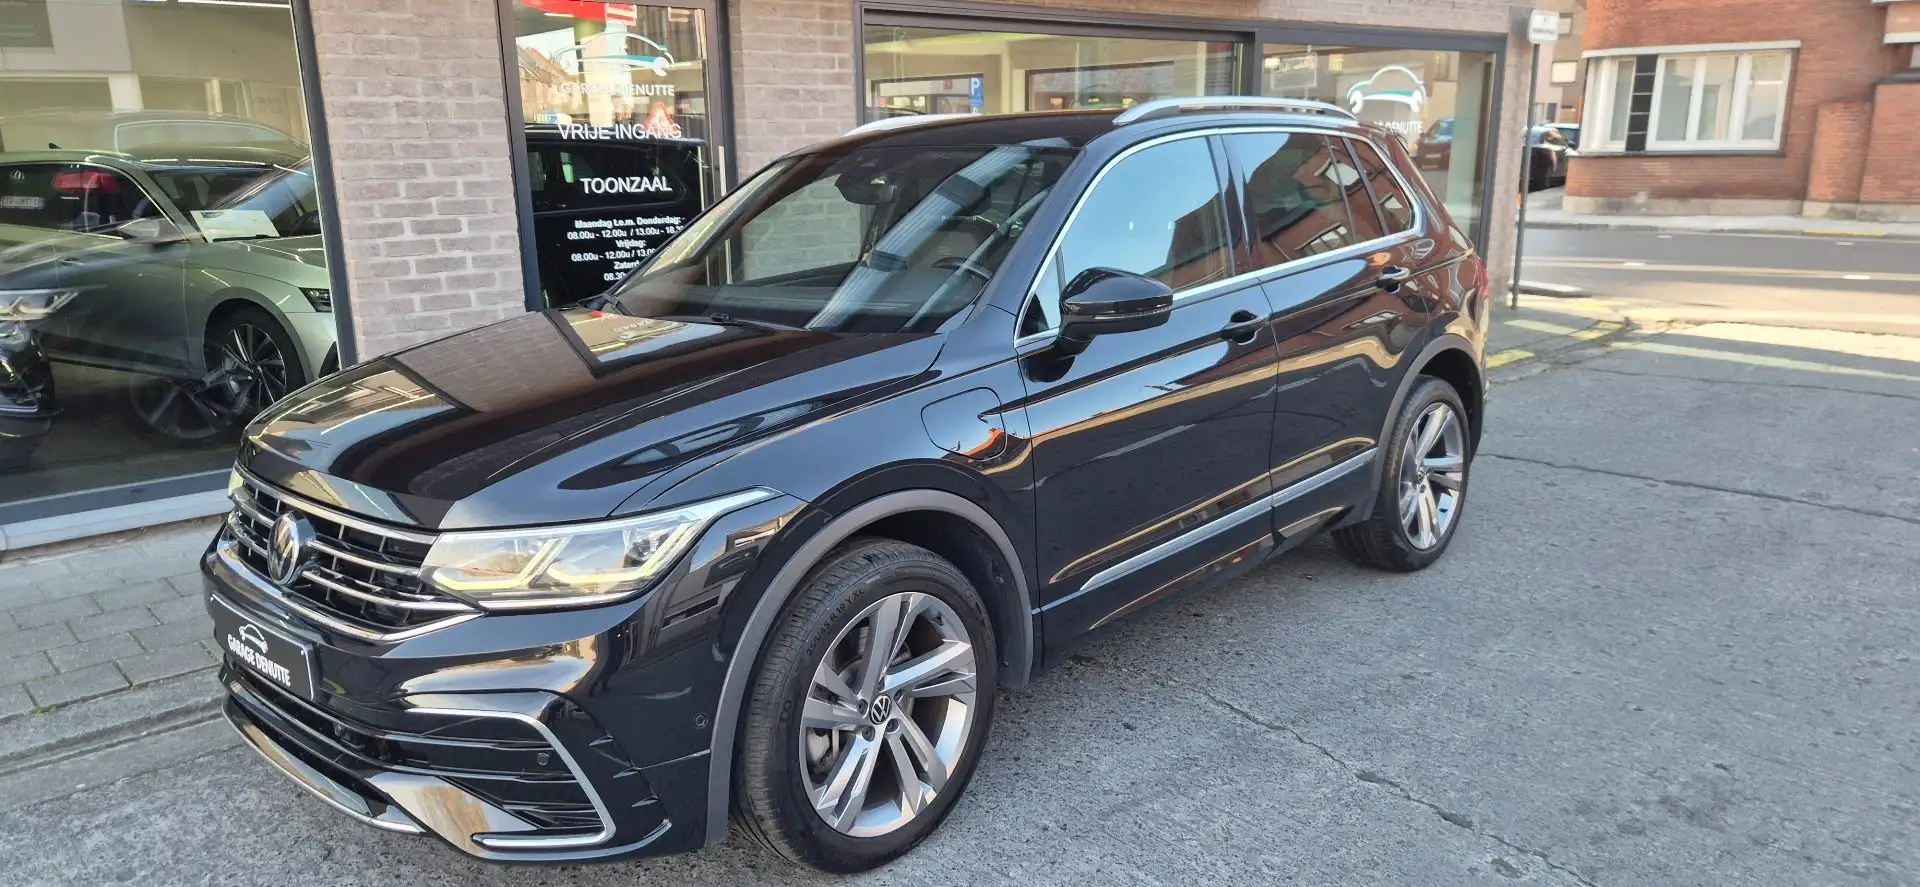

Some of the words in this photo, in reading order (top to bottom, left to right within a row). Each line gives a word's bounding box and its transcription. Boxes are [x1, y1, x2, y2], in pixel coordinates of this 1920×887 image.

[560, 84, 613, 95] GARA
[621, 84, 675, 96] ENUTTE
[557, 123, 611, 139] VRIJE
[615, 123, 682, 139] INGANG
[580, 175, 673, 194] TOONZAAL
[574, 219, 613, 229] Maandag
[637, 216, 682, 225] Donderdag:
[567, 231, 595, 240] 08.00u
[601, 229, 627, 238] 12.00u
[635, 227, 660, 236] 13.00u
[615, 239, 647, 249] Vrijdag:
[571, 252, 599, 261] 08.00u
[605, 250, 631, 259] 12.00u
[227, 634, 256, 666] GARAGE
[255, 652, 291, 687] DENUTTE
